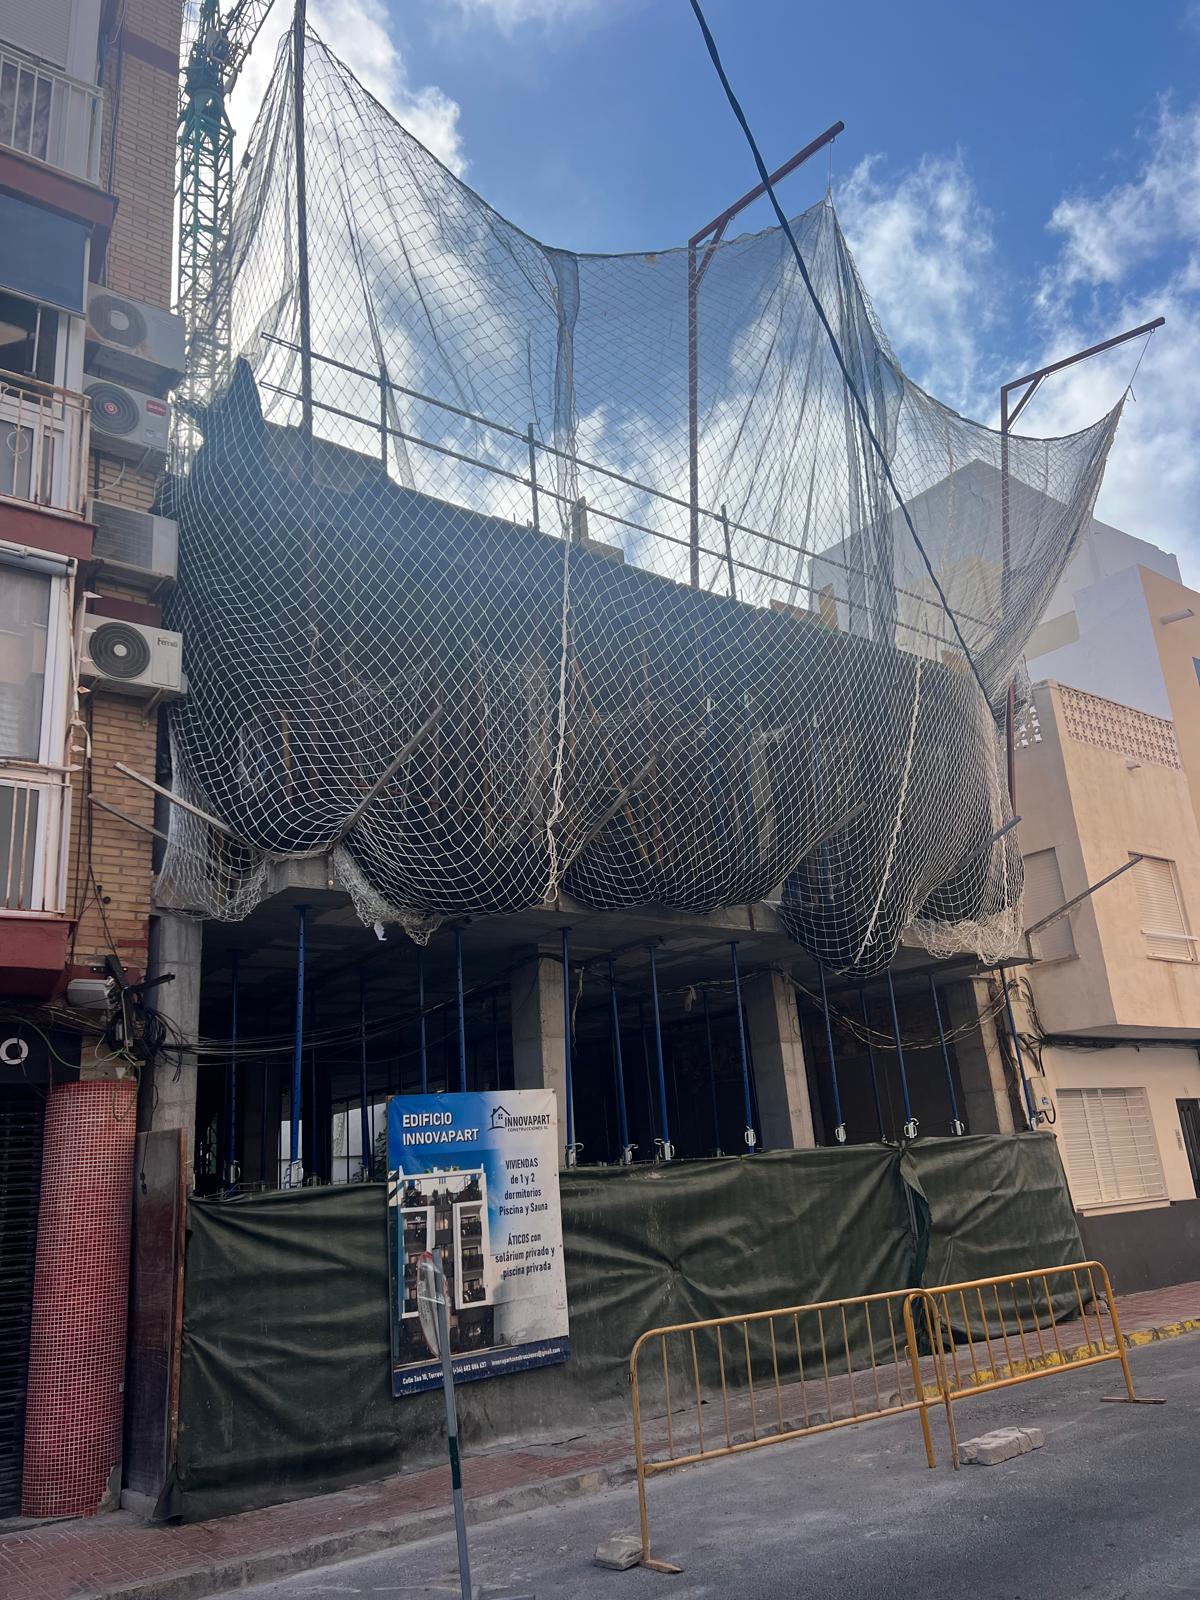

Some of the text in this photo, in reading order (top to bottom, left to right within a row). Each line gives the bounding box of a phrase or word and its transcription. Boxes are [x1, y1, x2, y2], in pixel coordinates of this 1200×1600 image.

[402, 1112, 453, 1128] EDIFICIO
[505, 1114, 550, 1127] INNOVAPART
[403, 1128, 480, 1146] INNOVAPART
[505, 1157, 539, 1170] VIVIENDAS
[510, 1172, 535, 1185] de 1 y 2
[504, 1187, 542, 1200] dormitorios
[499, 1202, 548, 1216] Piscina y Sauna
[508, 1232, 542, 1246] ÁTICOS con
[495, 1246, 555, 1263] solárium privado y
[502, 1261, 552, 1281] piscina privada
